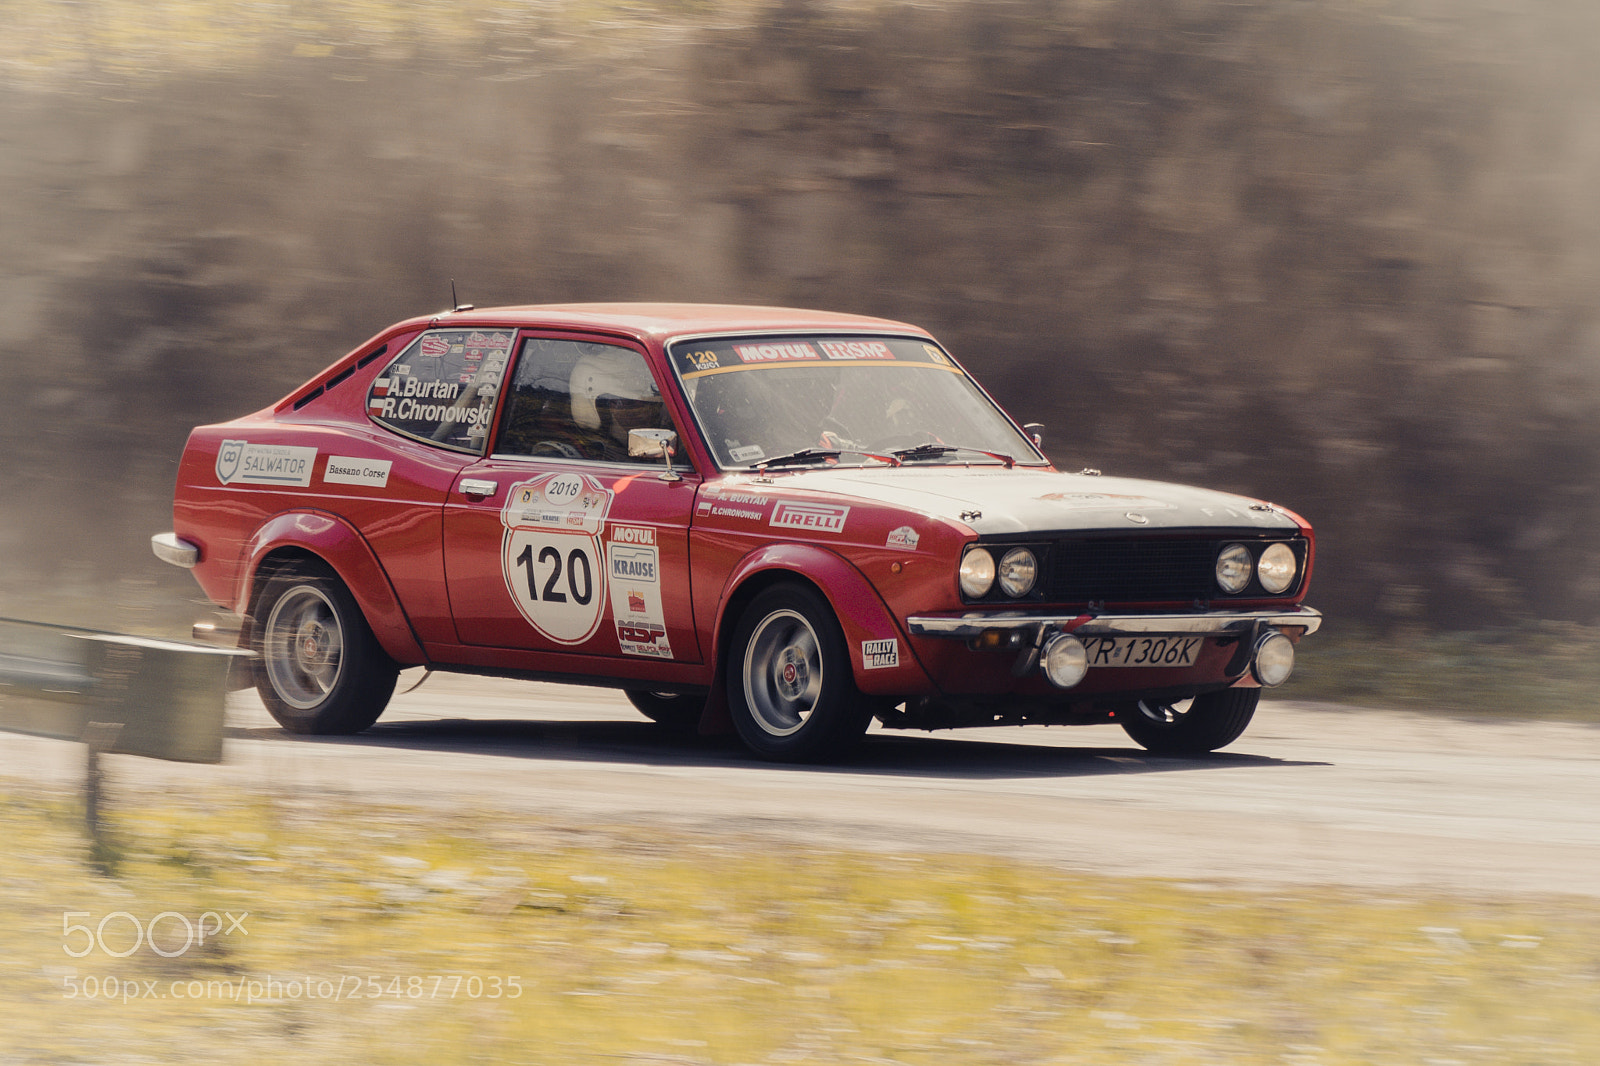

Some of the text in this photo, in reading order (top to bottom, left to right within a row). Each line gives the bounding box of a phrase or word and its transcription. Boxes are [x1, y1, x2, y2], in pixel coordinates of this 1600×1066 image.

[686, 350, 718, 365] 120
[740, 343, 817, 361] MOTUL
[387, 376, 459, 399] A.Burtan
[381, 397, 492, 425] R.Chronowski
[244, 456, 306, 474] SALWATOR
[329, 464, 386, 479] Bassano Corse
[549, 481, 579, 496] 2018
[730, 494, 768, 506] BURTAN
[711, 506, 762, 521] R.CHRONOWSKI
[774, 504, 844, 529] PIRELLI
[614, 527, 654, 544] MOTUL
[516, 544, 593, 606] 120
[613, 558, 654, 578] KRAUSE
[865, 641, 893, 655] RALLY
[1124, 638, 1199, 664] 1306K
[873, 653, 896, 667] RACE
